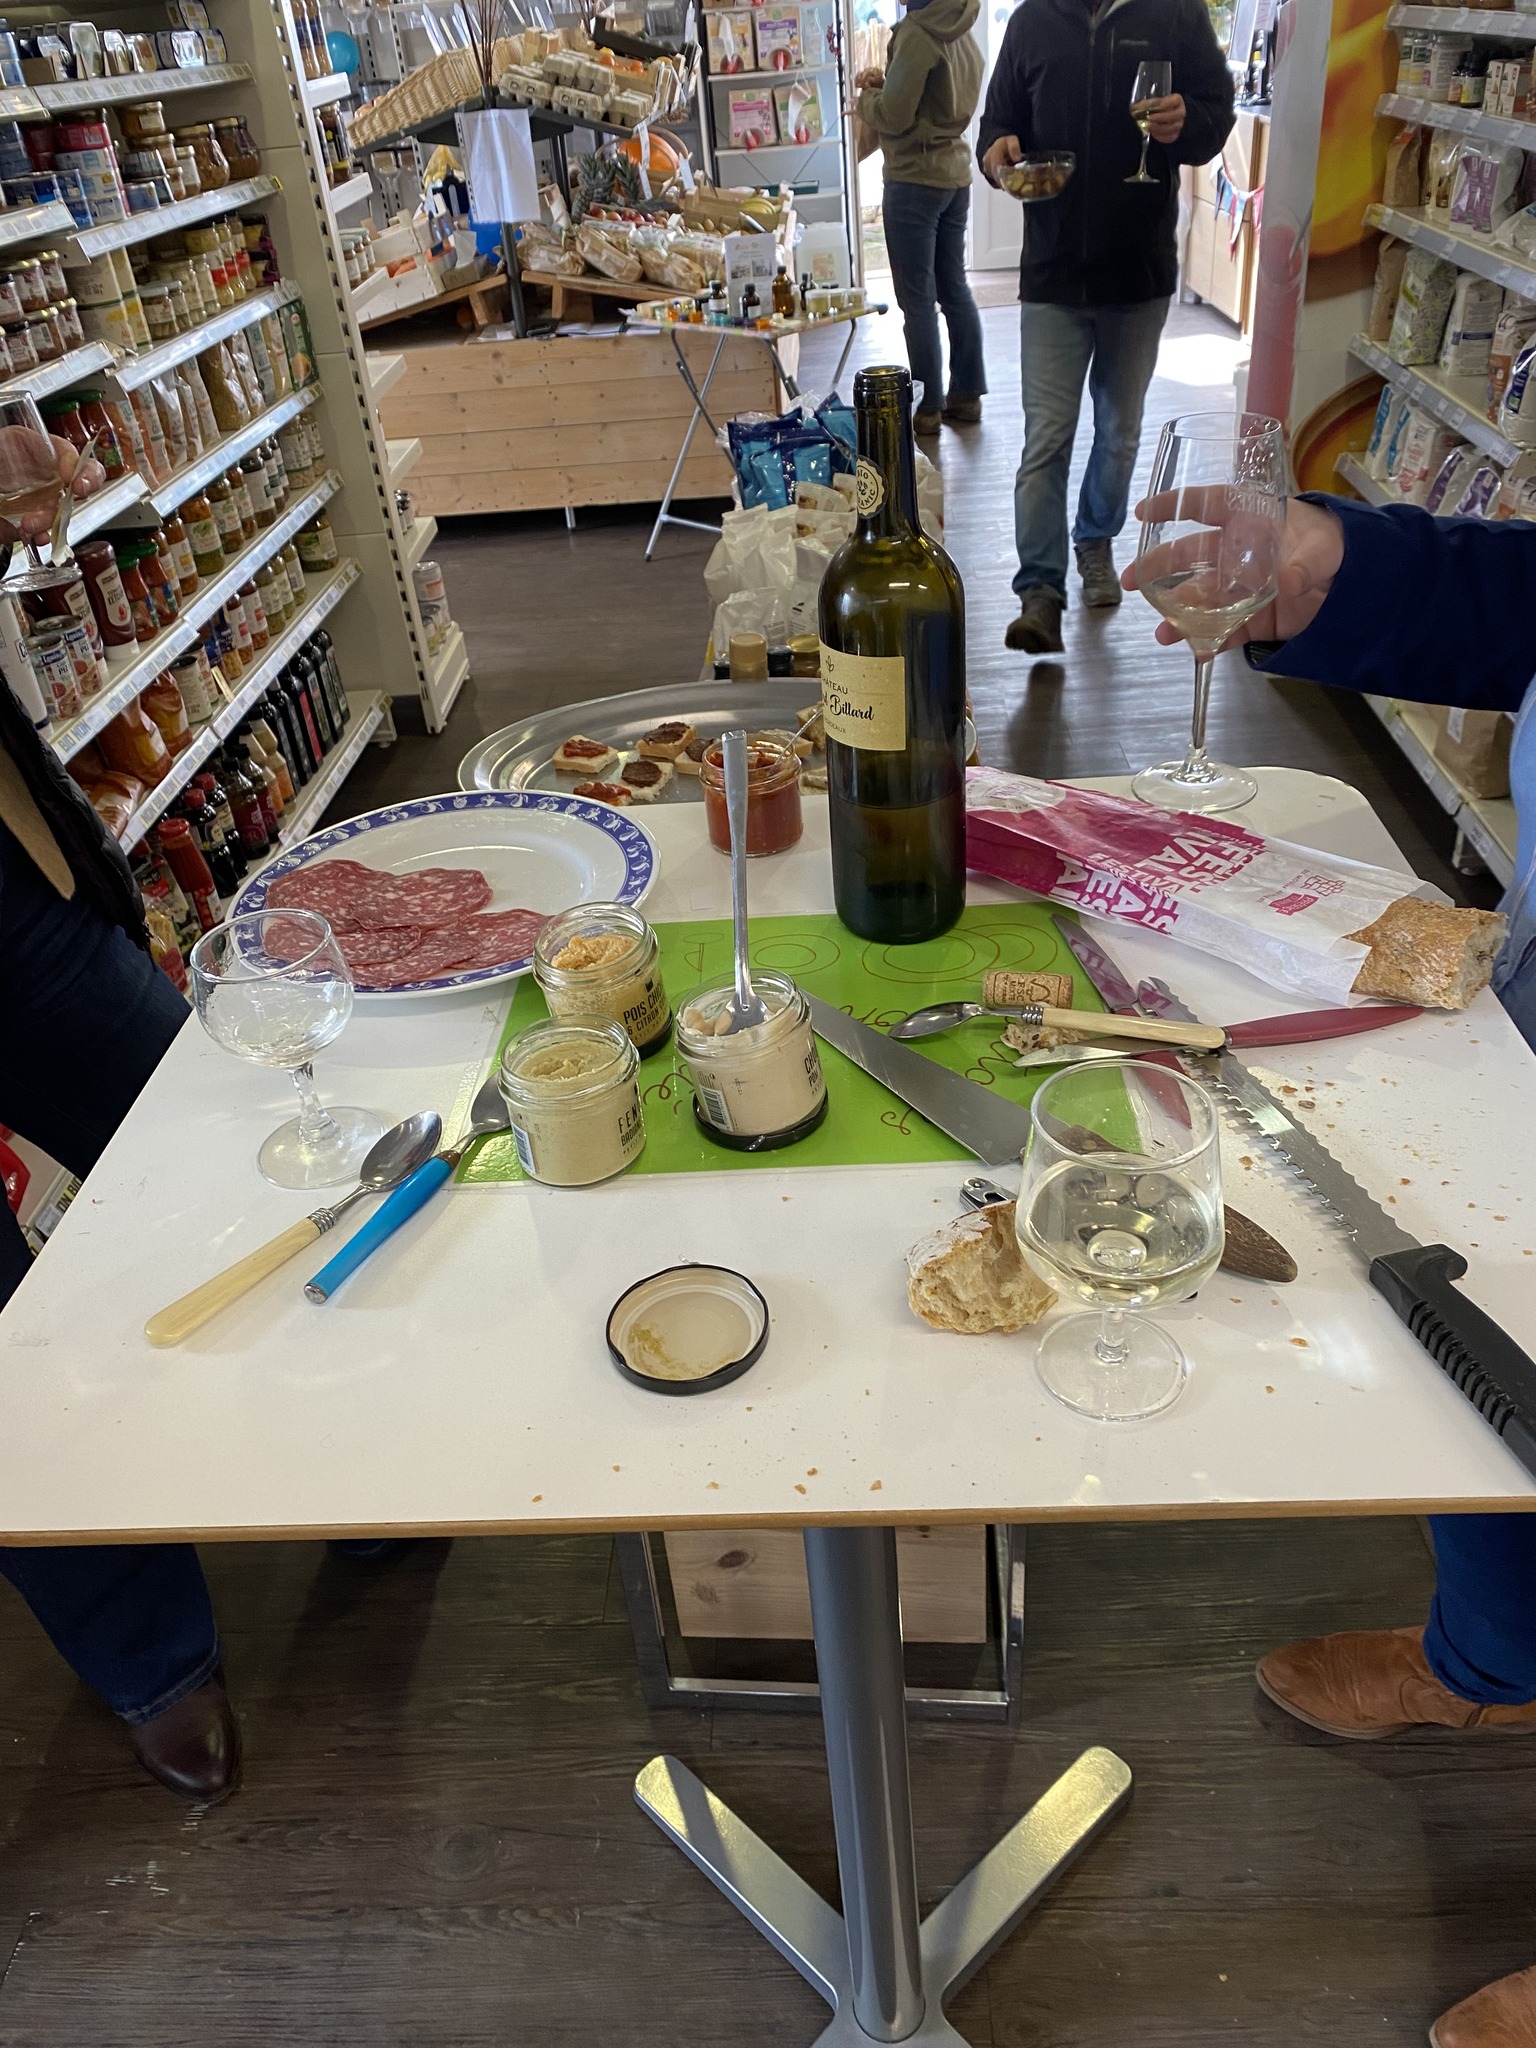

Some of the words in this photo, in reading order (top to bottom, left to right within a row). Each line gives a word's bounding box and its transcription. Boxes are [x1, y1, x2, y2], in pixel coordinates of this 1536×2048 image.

[829, 694, 875, 721] Billard
[57, 735, 77, 752] BIO
[70, 719, 92, 741] NON
[1134, 831, 1213, 873] IVAL
[1165, 841, 1251, 893] FEST
[1016, 980, 1026, 1002] FSC
[623, 1000, 647, 1025] POIS
[636, 1006, 660, 1032] CITRON
[617, 1102, 640, 1134] FEN
